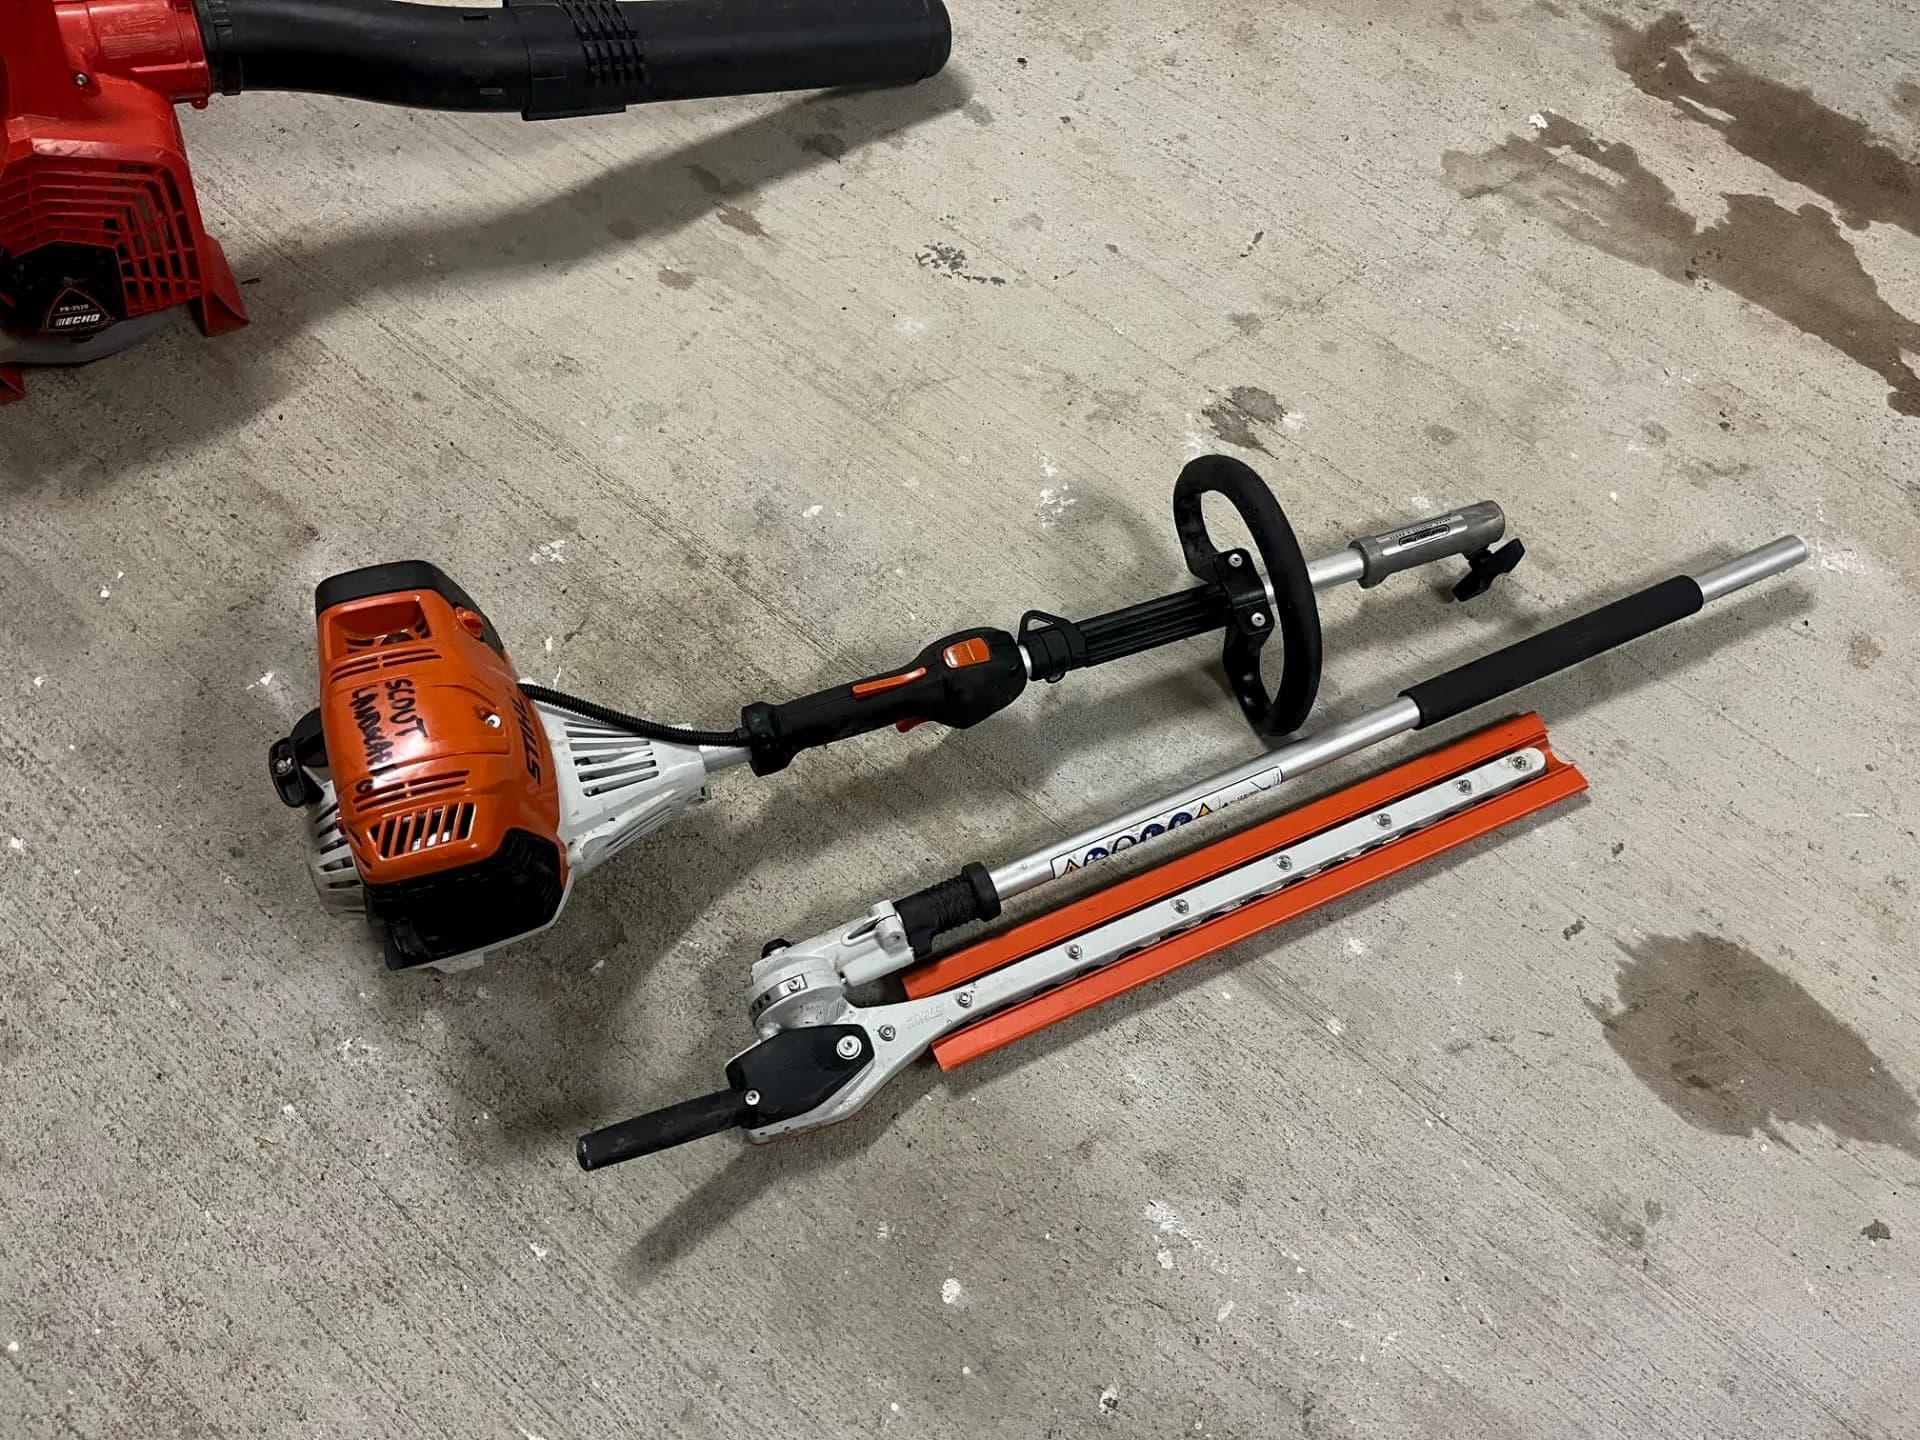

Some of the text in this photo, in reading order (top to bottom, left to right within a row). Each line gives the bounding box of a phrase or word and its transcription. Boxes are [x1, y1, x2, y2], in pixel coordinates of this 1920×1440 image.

[65, 313, 101, 326] ECHO
[385, 678, 429, 738] SCOUT
[510, 696, 541, 786] STIHL
